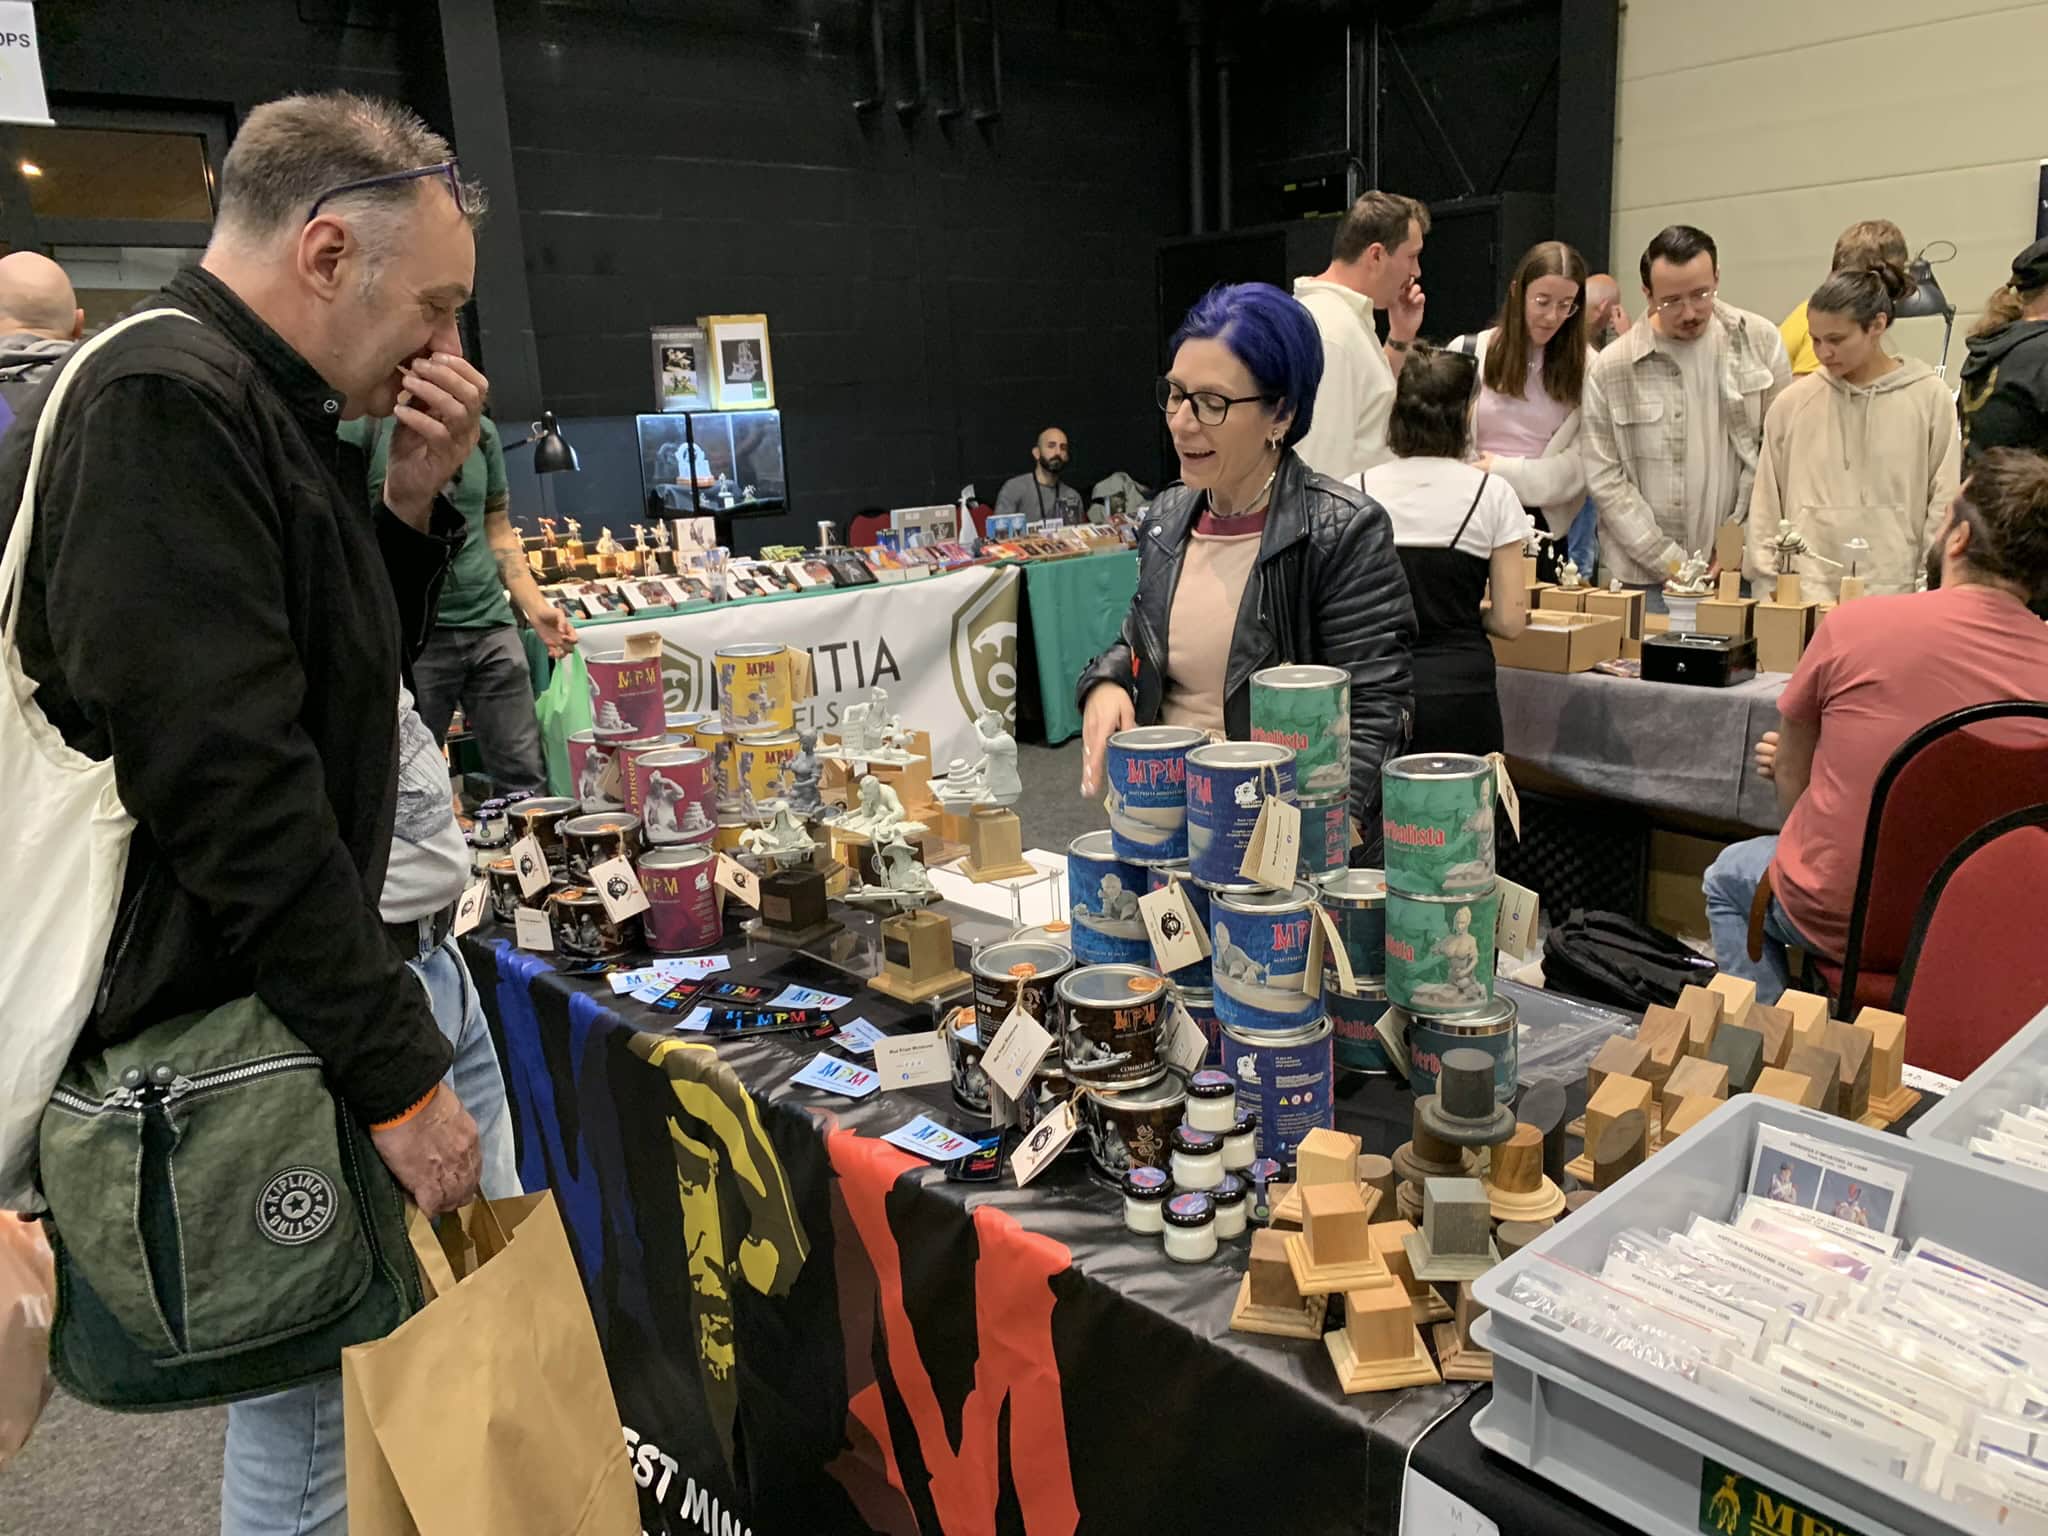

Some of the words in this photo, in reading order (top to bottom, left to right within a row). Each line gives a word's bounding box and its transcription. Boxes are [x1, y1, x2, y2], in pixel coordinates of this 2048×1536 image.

[618, 668, 657, 689] MPM
[746, 661, 775, 676] MPM
[1127, 757, 1186, 790] MPM
[1187, 772, 1214, 808] PM
[1271, 919, 1310, 953] MP
[655, 985, 698, 1009] MPM
[720, 983, 761, 999] MPM
[792, 990, 836, 1006] MPM
[757, 1010, 807, 1026] MPM
[1113, 1003, 1157, 1032] MPM
[818, 1061, 870, 1087] MPM
[912, 1124, 965, 1152] MPM
[266, 1175, 322, 1204] KIPLING
[268, 1204, 327, 1235] KIPLING
[680, 1477, 752, 1536] MIN
